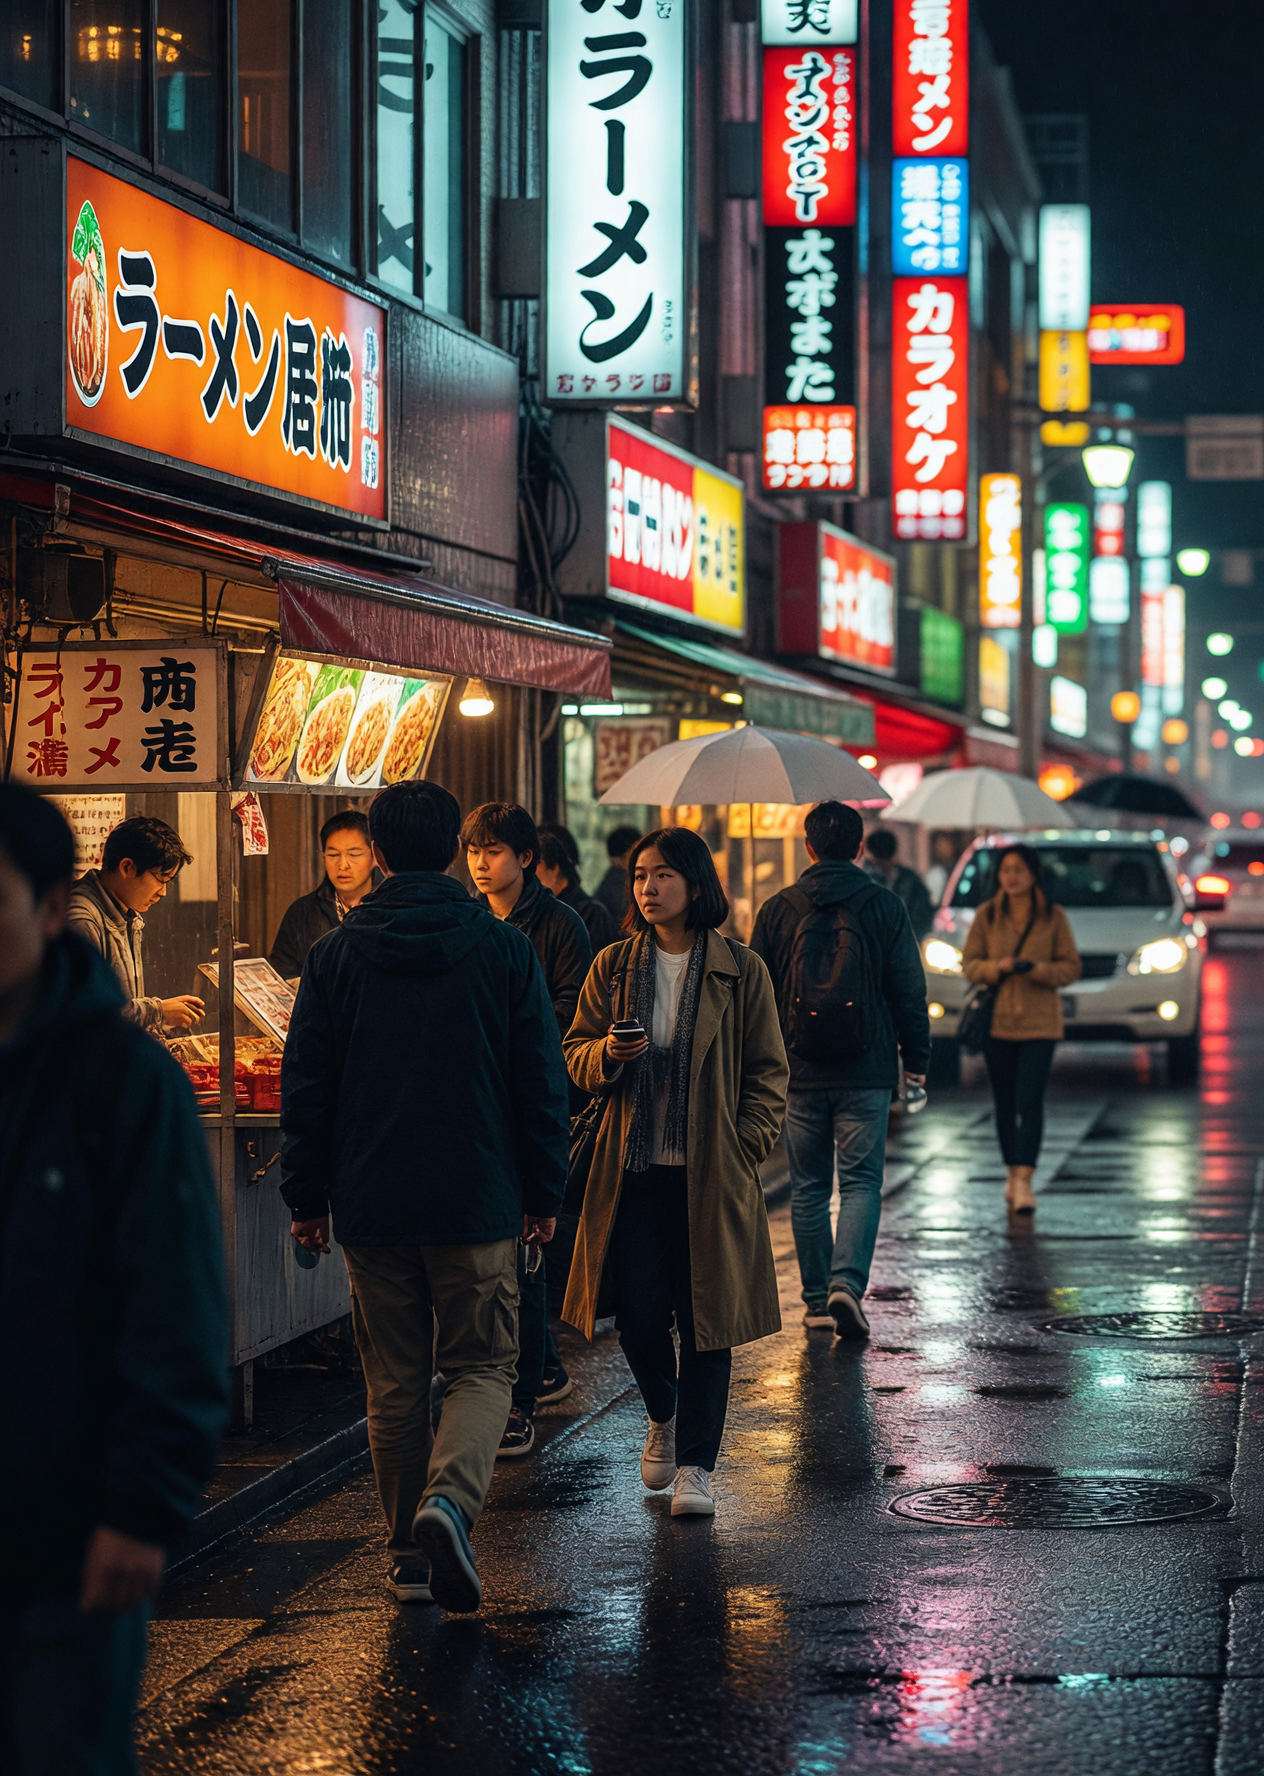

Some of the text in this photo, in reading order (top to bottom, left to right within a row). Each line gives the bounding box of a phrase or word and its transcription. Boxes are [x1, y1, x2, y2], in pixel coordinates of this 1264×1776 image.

[578, 0, 653, 363] ラーメン
[906, 283, 957, 484] カラオケ
